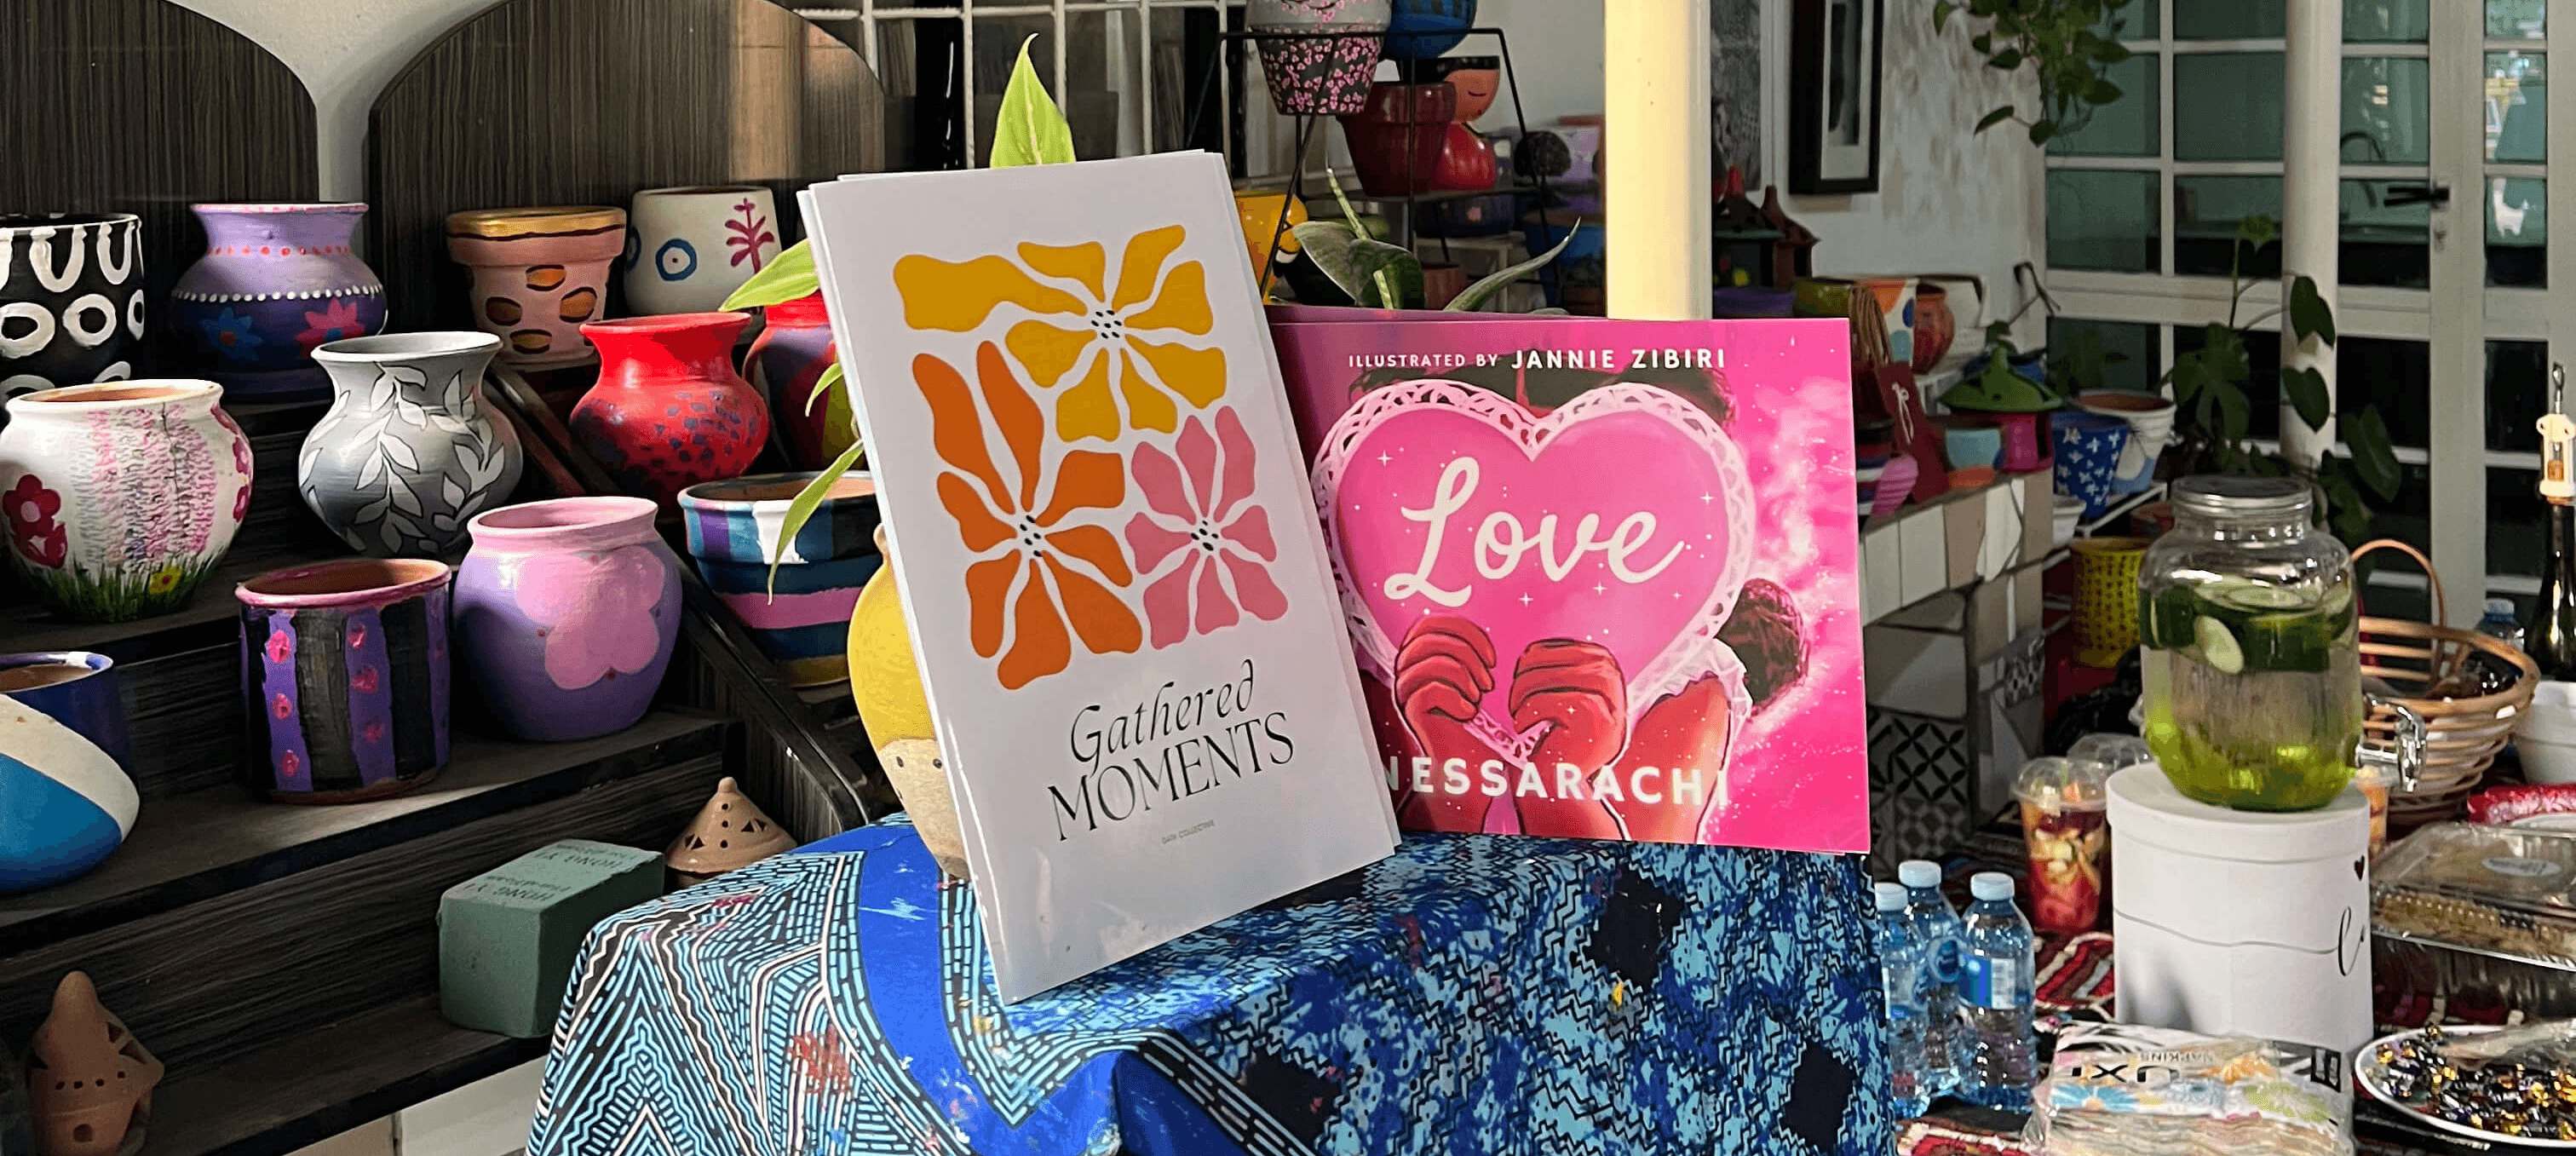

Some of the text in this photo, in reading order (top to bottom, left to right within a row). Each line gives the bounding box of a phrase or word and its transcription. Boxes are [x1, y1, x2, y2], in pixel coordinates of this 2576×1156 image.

[1348, 348, 1726, 369] ILLUSTRATED BY JANNIE ZIBIRI
[1383, 456, 1685, 607] Love
[1048, 712, 1295, 841] MOMENTS
[1071, 659, 1254, 779] Gathered
